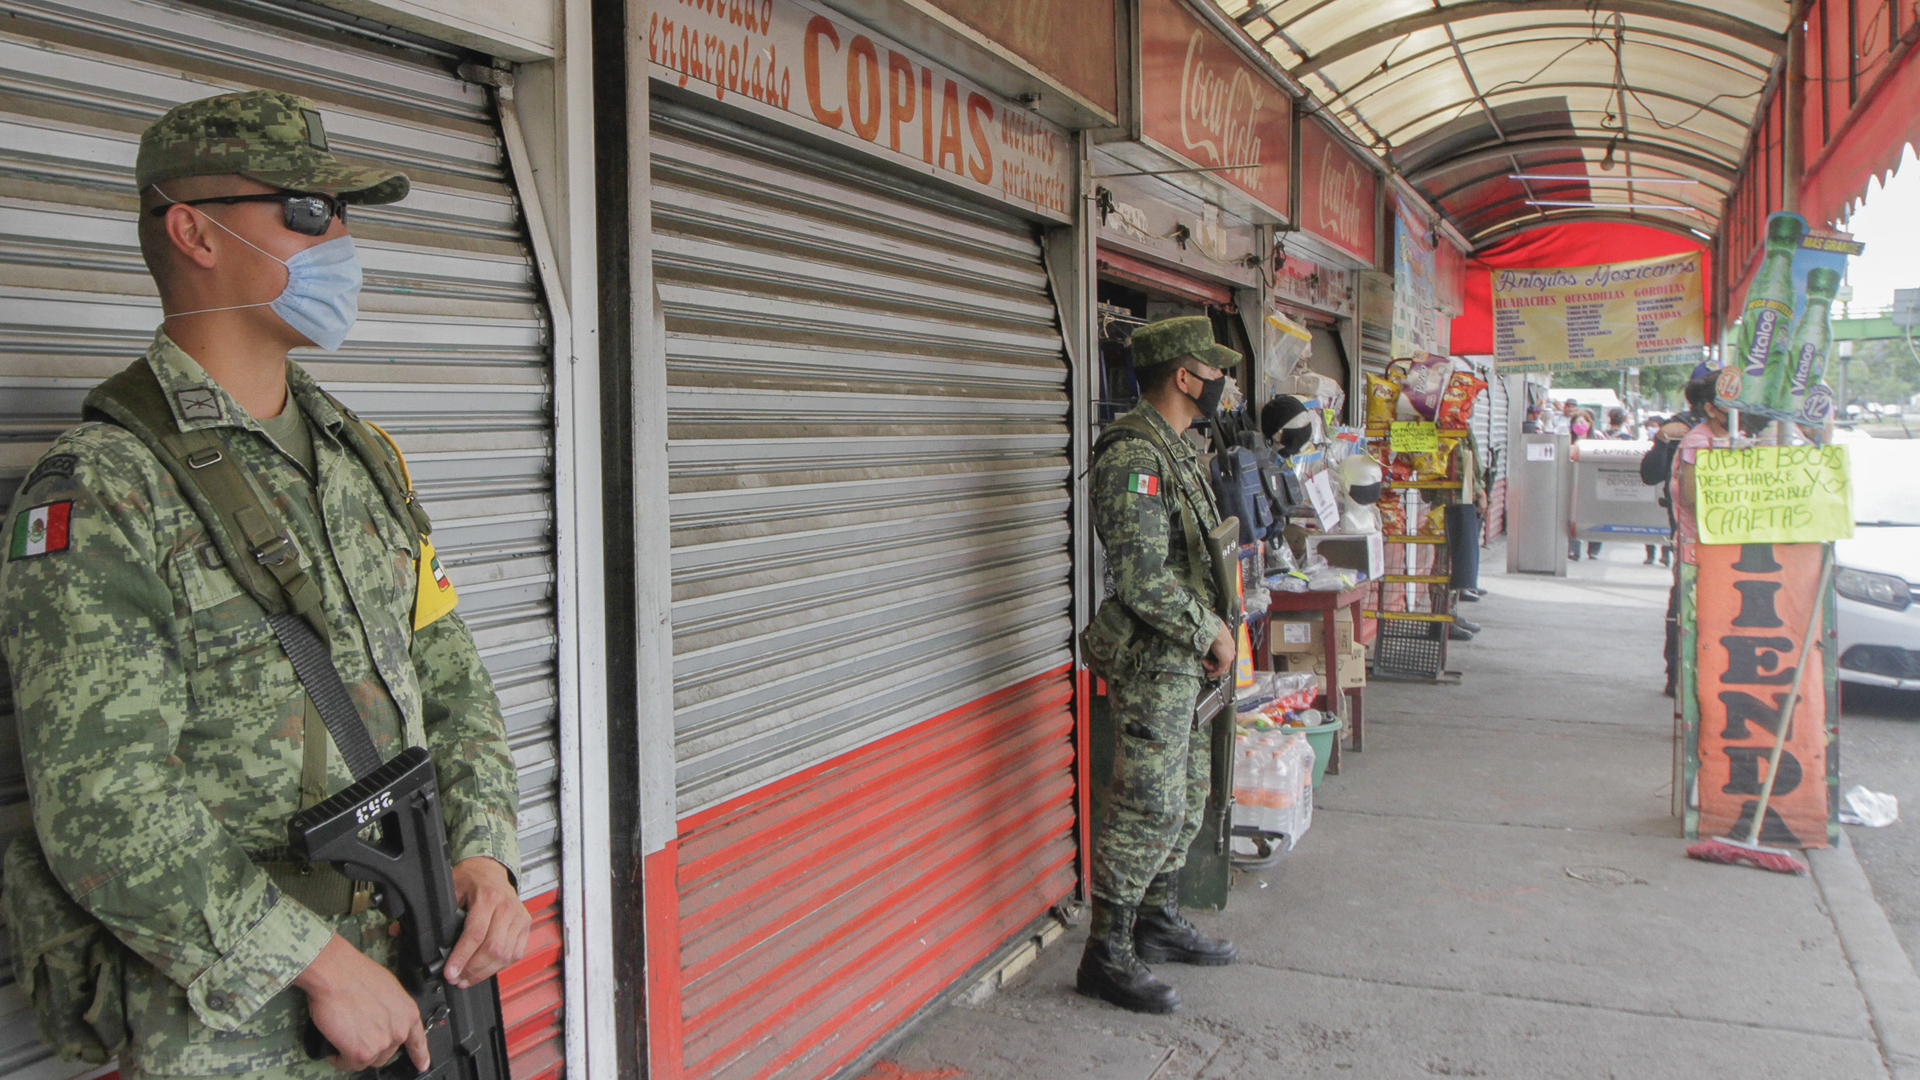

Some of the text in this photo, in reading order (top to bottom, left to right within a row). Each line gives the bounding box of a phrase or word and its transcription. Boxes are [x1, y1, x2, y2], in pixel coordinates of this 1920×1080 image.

[648, 11, 790, 110] engargolado
[803, 15, 994, 185] COPIAS
[1495, 295, 1556, 309] HUARACHES
[1564, 290, 1625, 303] QUESADILLAS
[1634, 283, 1685, 297] GORDITAS
[1636, 310, 1682, 321] TOSTADAS
[1745, 310, 1775, 373] Vitaloe
[1790, 344, 1815, 393] Vitaloe
[1805, 394, 1830, 418] $12
[1776, 444, 1844, 470] BOCAS
[1705, 503, 1814, 535] CARETAS
